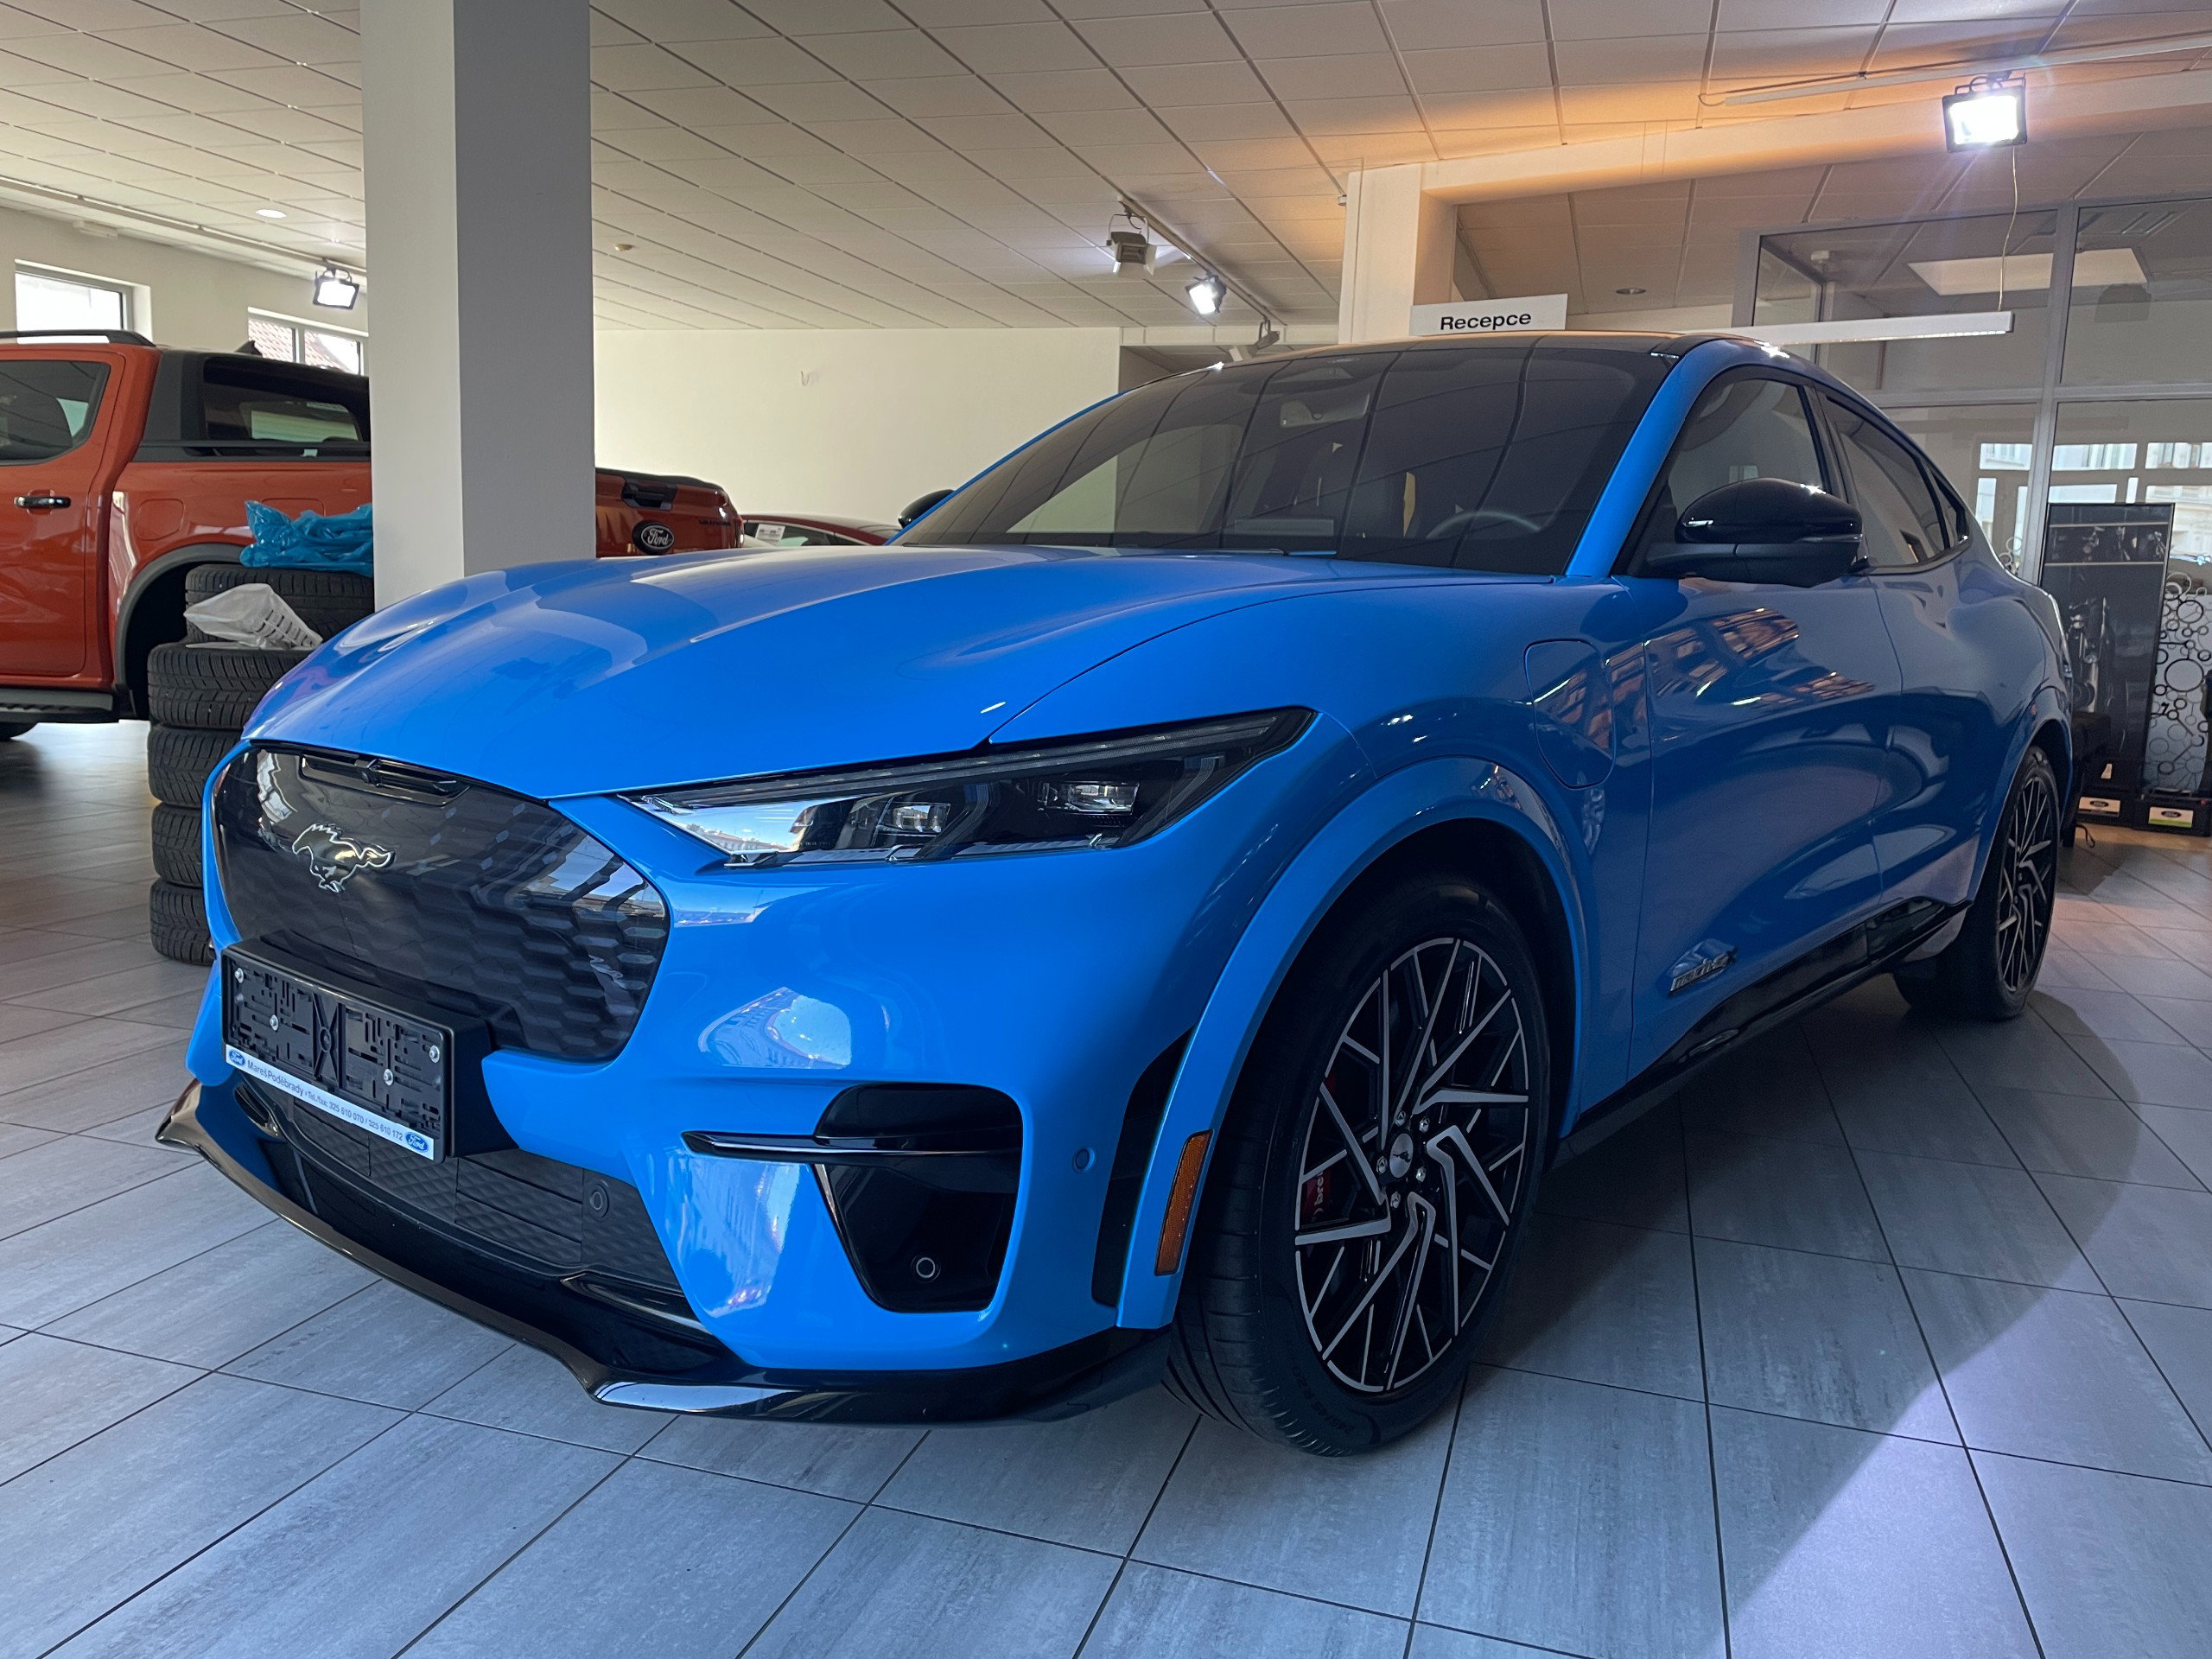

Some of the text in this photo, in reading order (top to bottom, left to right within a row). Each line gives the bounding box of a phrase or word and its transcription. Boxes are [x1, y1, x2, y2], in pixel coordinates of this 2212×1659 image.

[1440, 313, 1532, 330] Recepce
[647, 527, 671, 546] Ford
[247, 1059, 268, 1077] Mareš
[268, 1070, 304, 1096] Poděbrady
[329, 1101, 340, 1113] 325
[341, 1106, 352, 1117] 610
[353, 1112, 365, 1123] 070
[368, 1119, 379, 1130] 325
[380, 1124, 391, 1135] 610
[392, 1129, 404, 1141] 172
[407, 1134, 426, 1151] Ford
